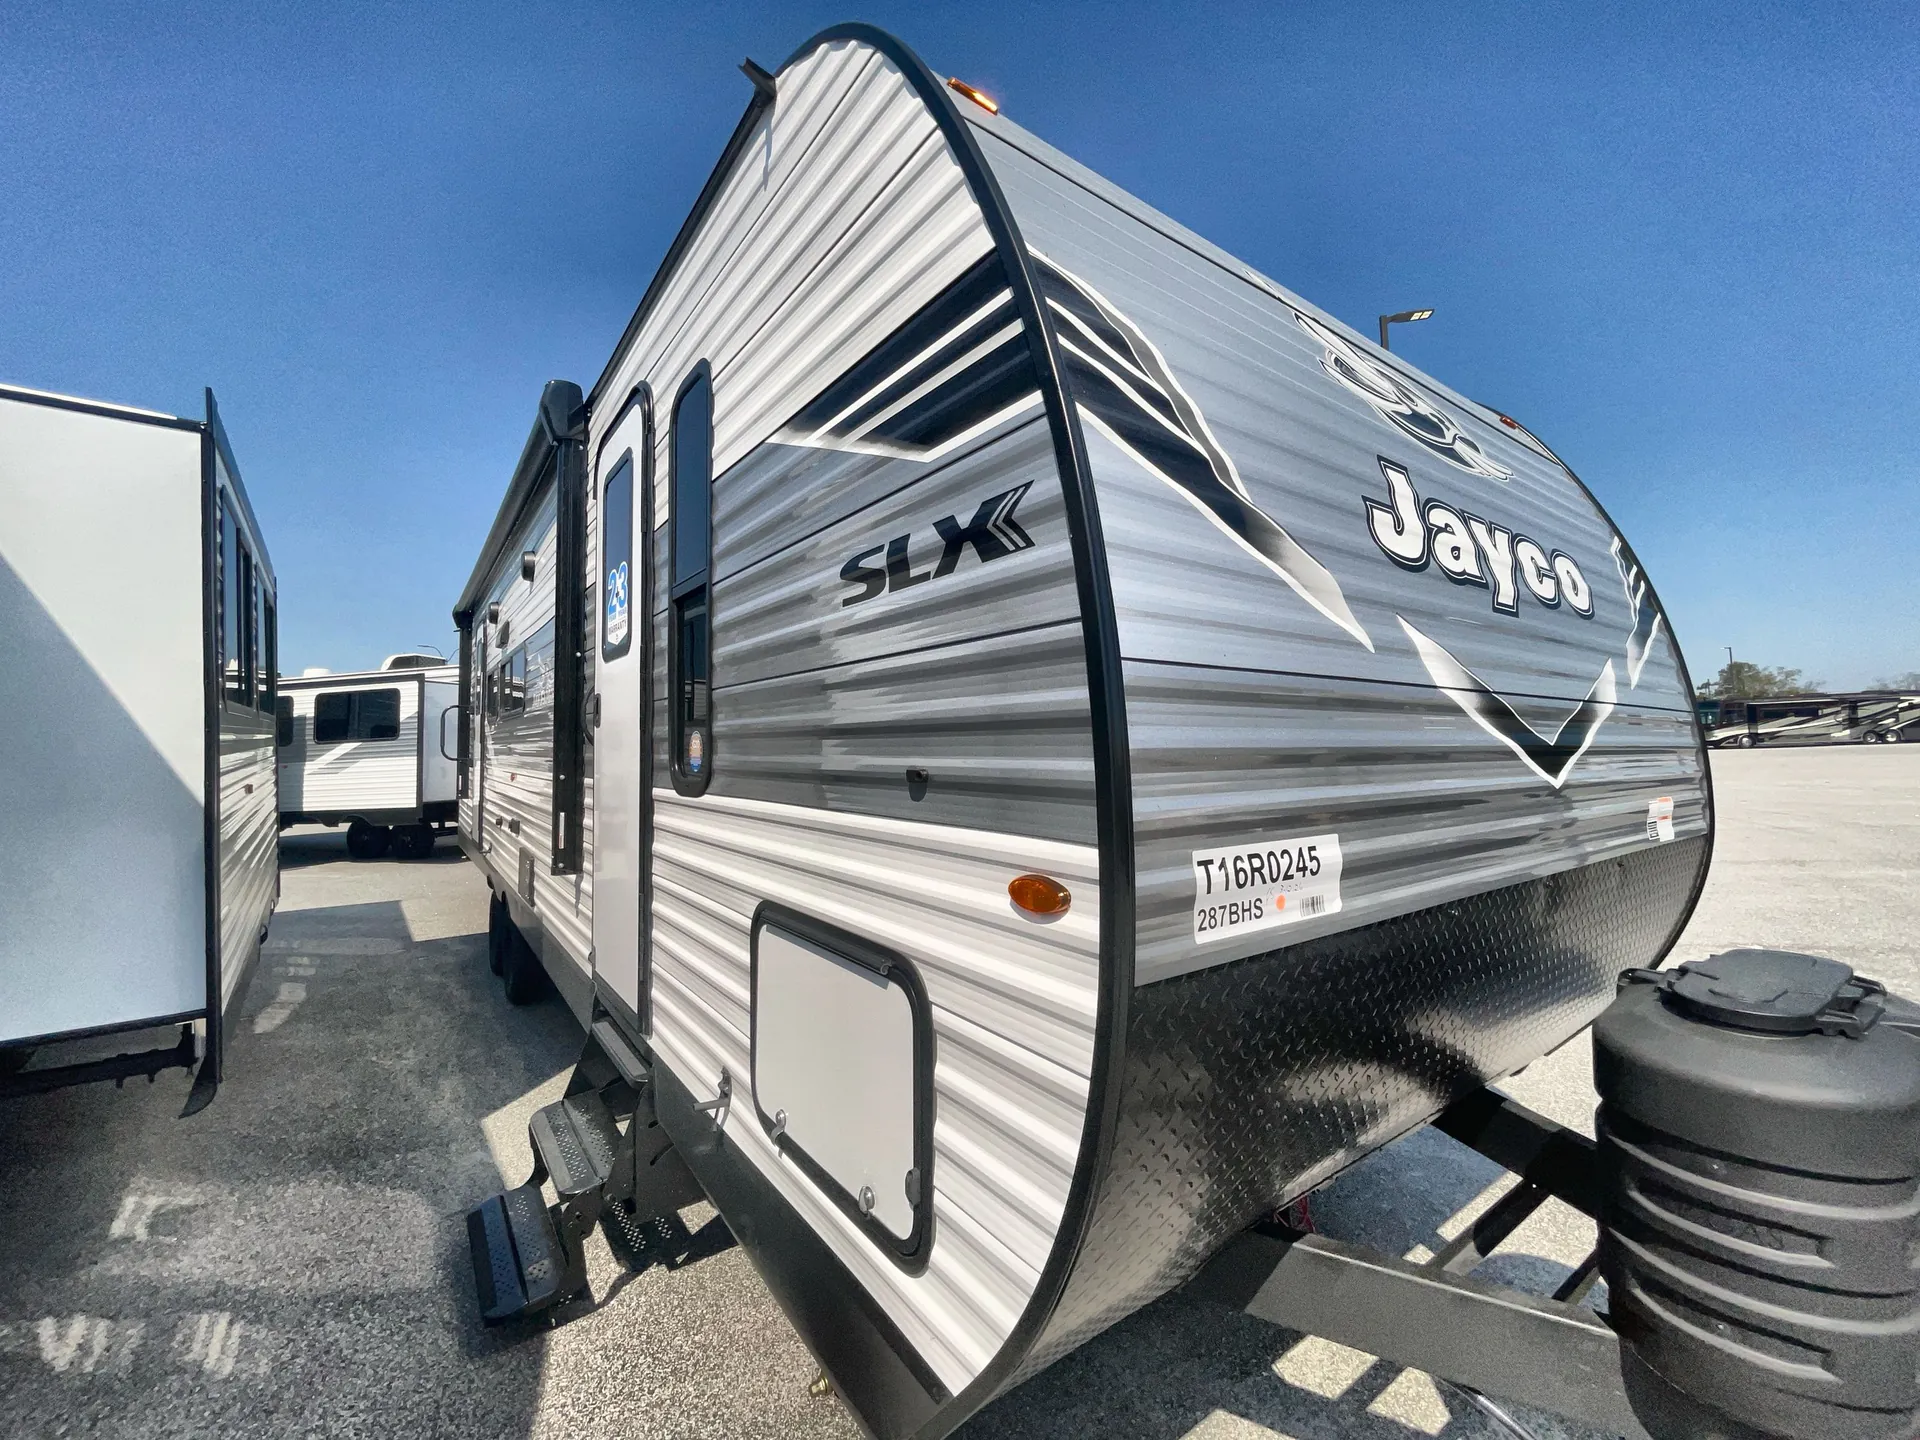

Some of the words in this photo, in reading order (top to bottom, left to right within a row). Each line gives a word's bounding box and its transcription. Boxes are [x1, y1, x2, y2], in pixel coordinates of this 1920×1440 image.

[839, 479, 1036, 608] SLX
[1361, 454, 1596, 621] Jayco
[1196, 845, 1321, 895] T16R0245
[1197, 897, 1264, 932] 287BHS
